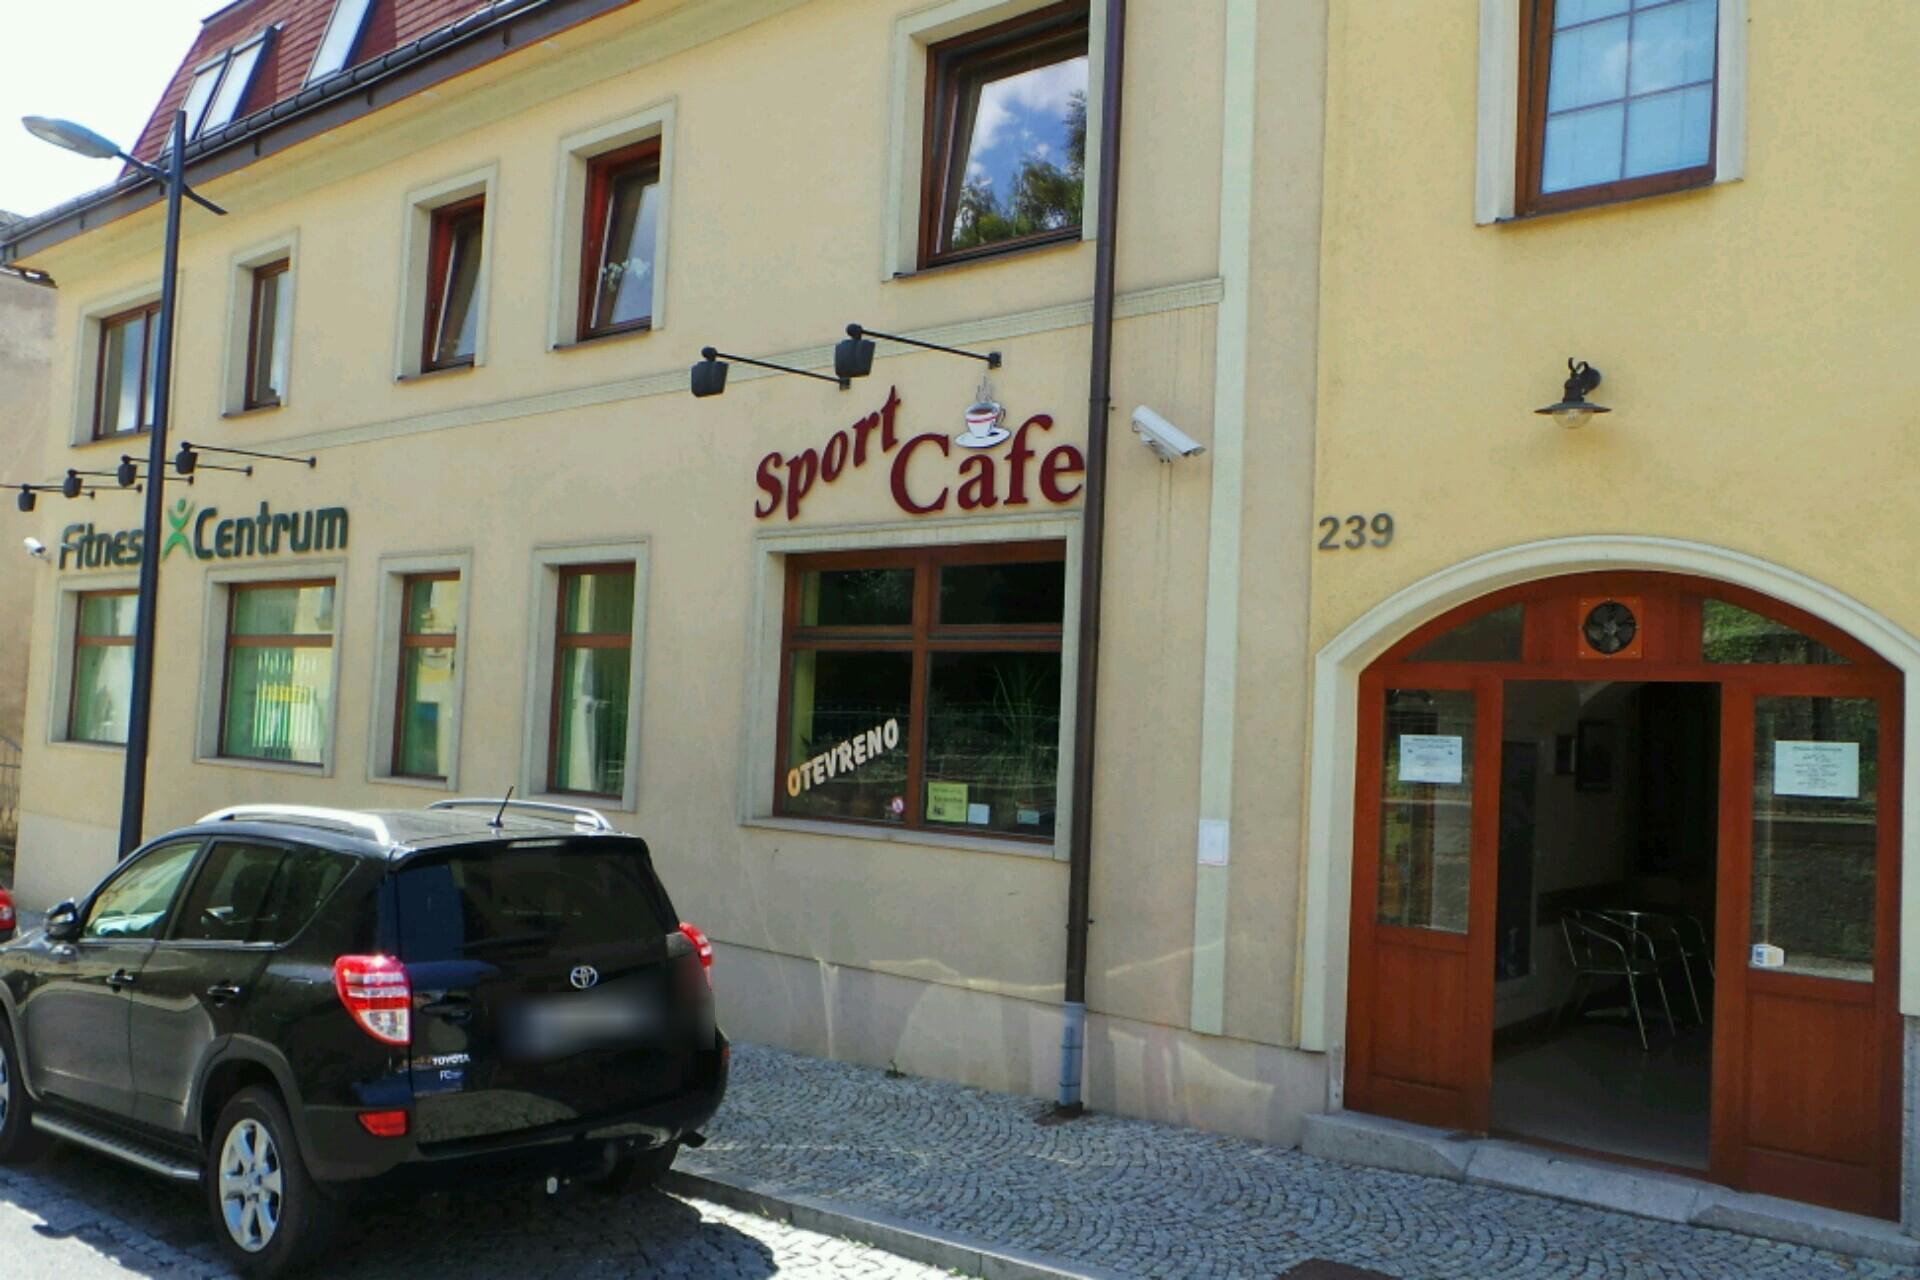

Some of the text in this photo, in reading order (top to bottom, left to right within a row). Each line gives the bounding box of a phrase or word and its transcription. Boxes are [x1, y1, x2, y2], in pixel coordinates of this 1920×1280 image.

[755, 385, 1085, 520] Sport Cafe
[59, 501, 349, 570] Fitnes Centrum
[1318, 512, 1394, 550] 239
[432, 1053, 470, 1066] TOYOTA
